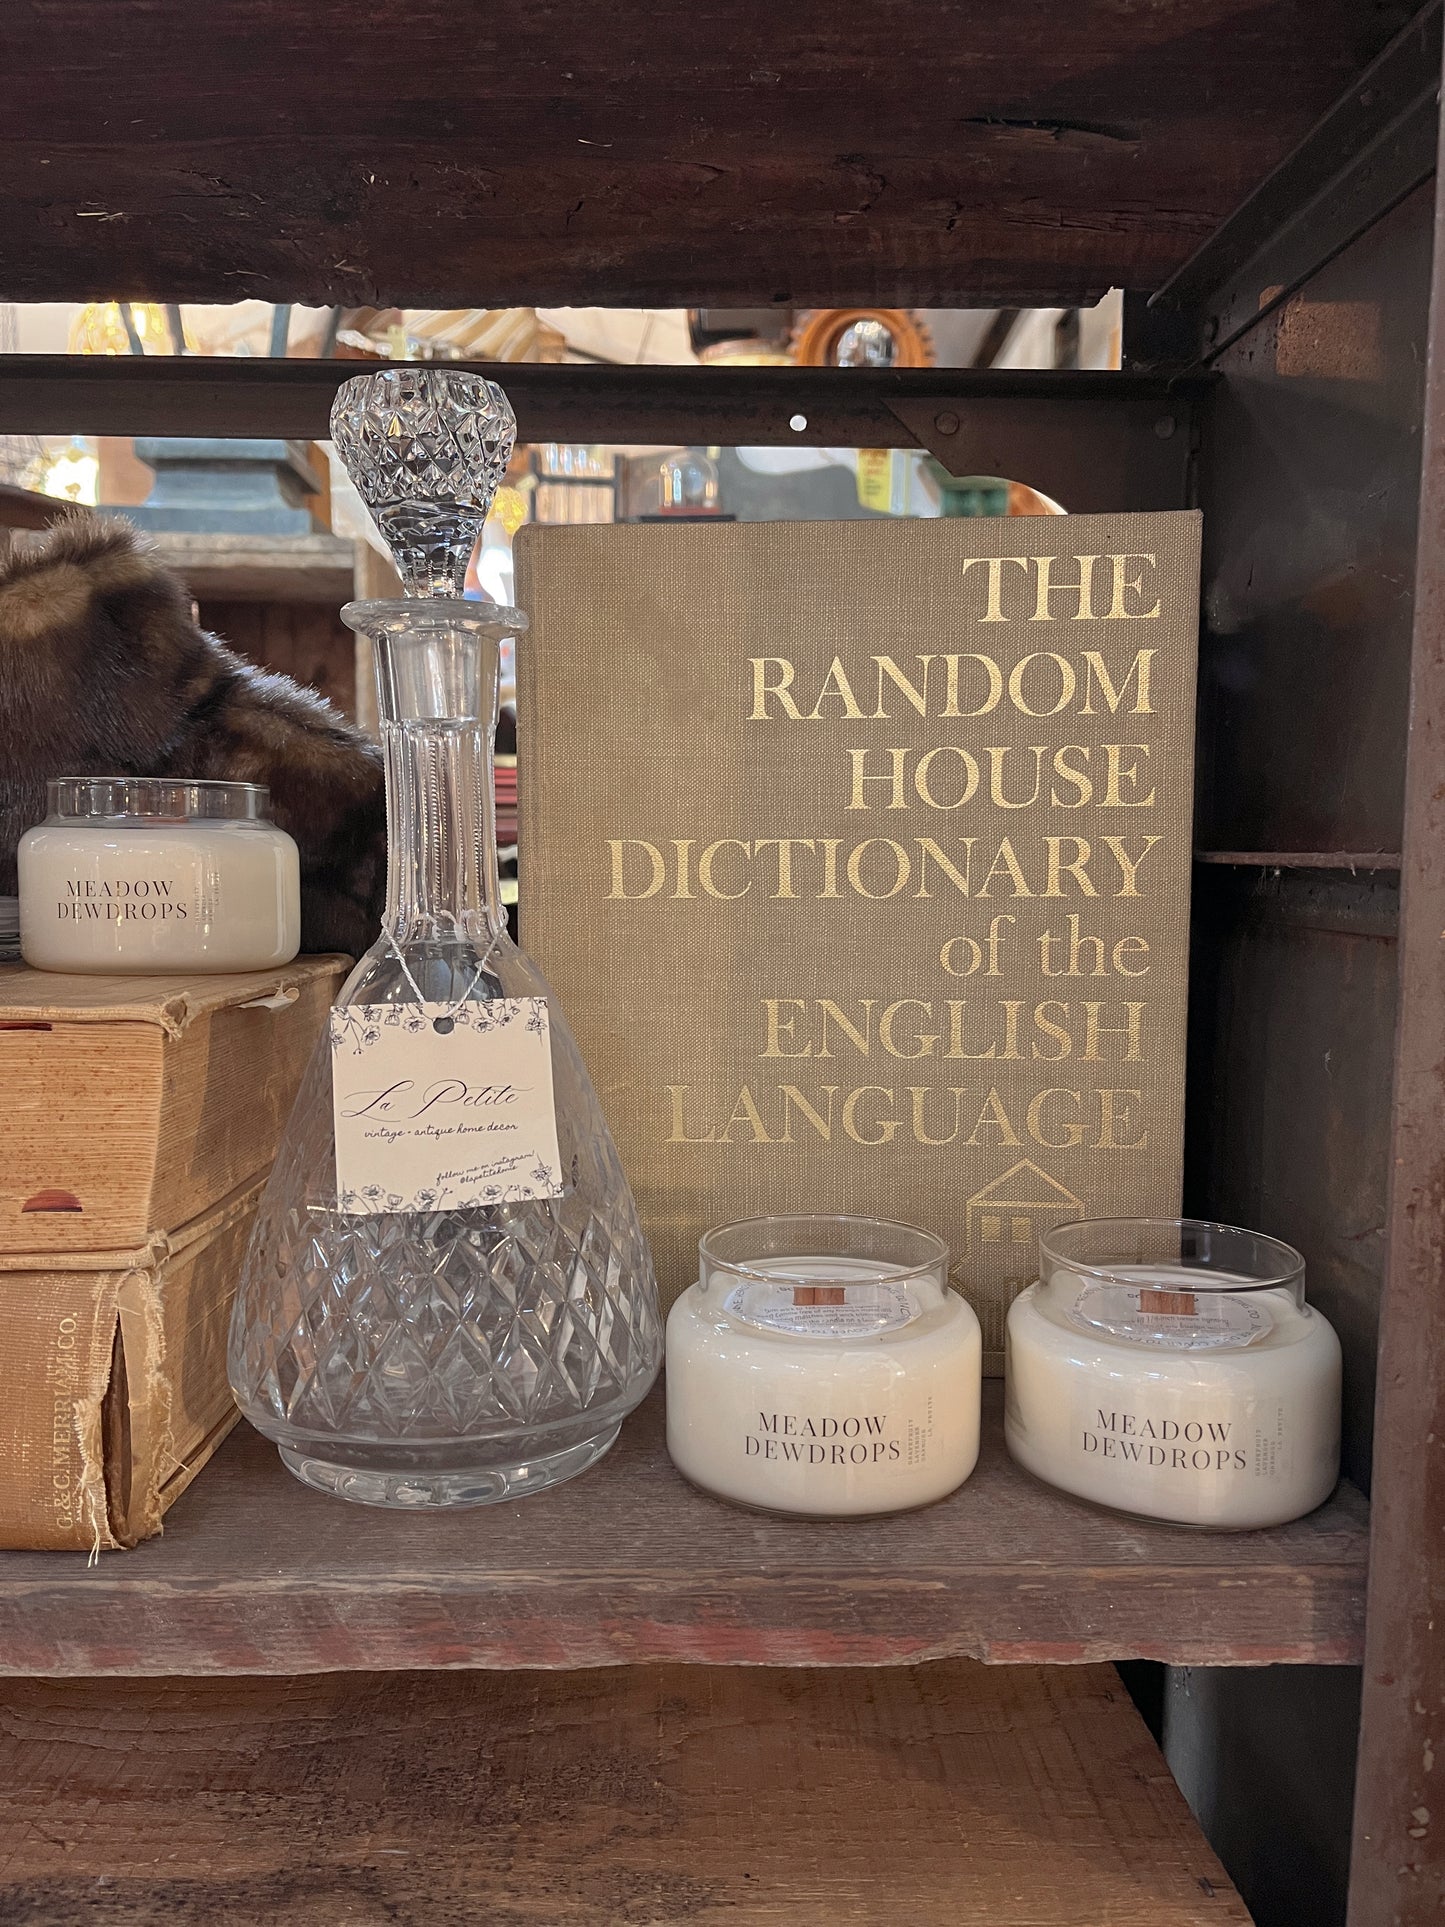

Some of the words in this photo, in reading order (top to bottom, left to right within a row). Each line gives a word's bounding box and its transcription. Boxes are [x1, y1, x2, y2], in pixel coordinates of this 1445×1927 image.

[962, 553, 1160, 622] THE
[746, 649, 1159, 720] RANDOM
[844, 744, 1155, 809] HOUSE
[603, 834, 1164, 900] DICTIONARY
[67, 880, 173, 897] MEADOW
[57, 902, 188, 920] DEWDROPS
[939, 914, 1016, 977] of
[1038, 914, 1150, 977] the
[758, 999, 1150, 1062] ENGLISH
[341, 1080, 414, 1122] La
[408, 1079, 535, 1119] Petite
[665, 1084, 1148, 1149] LANGUAGE
[364, 1126, 404, 1143] vintage
[414, 1124, 457, 1140] antique
[456, 1122, 486, 1134] home
[487, 1121, 518, 1132] decor
[436, 1170, 464, 1186] follow
[58, 1312, 78, 1350] CO.
[759, 1412, 887, 1438] MEADOW
[1097, 1409, 1233, 1443] MEADOW
[745, 1435, 900, 1465] DEWDROPS
[1082, 1431, 1247, 1470] DEWDROPS
